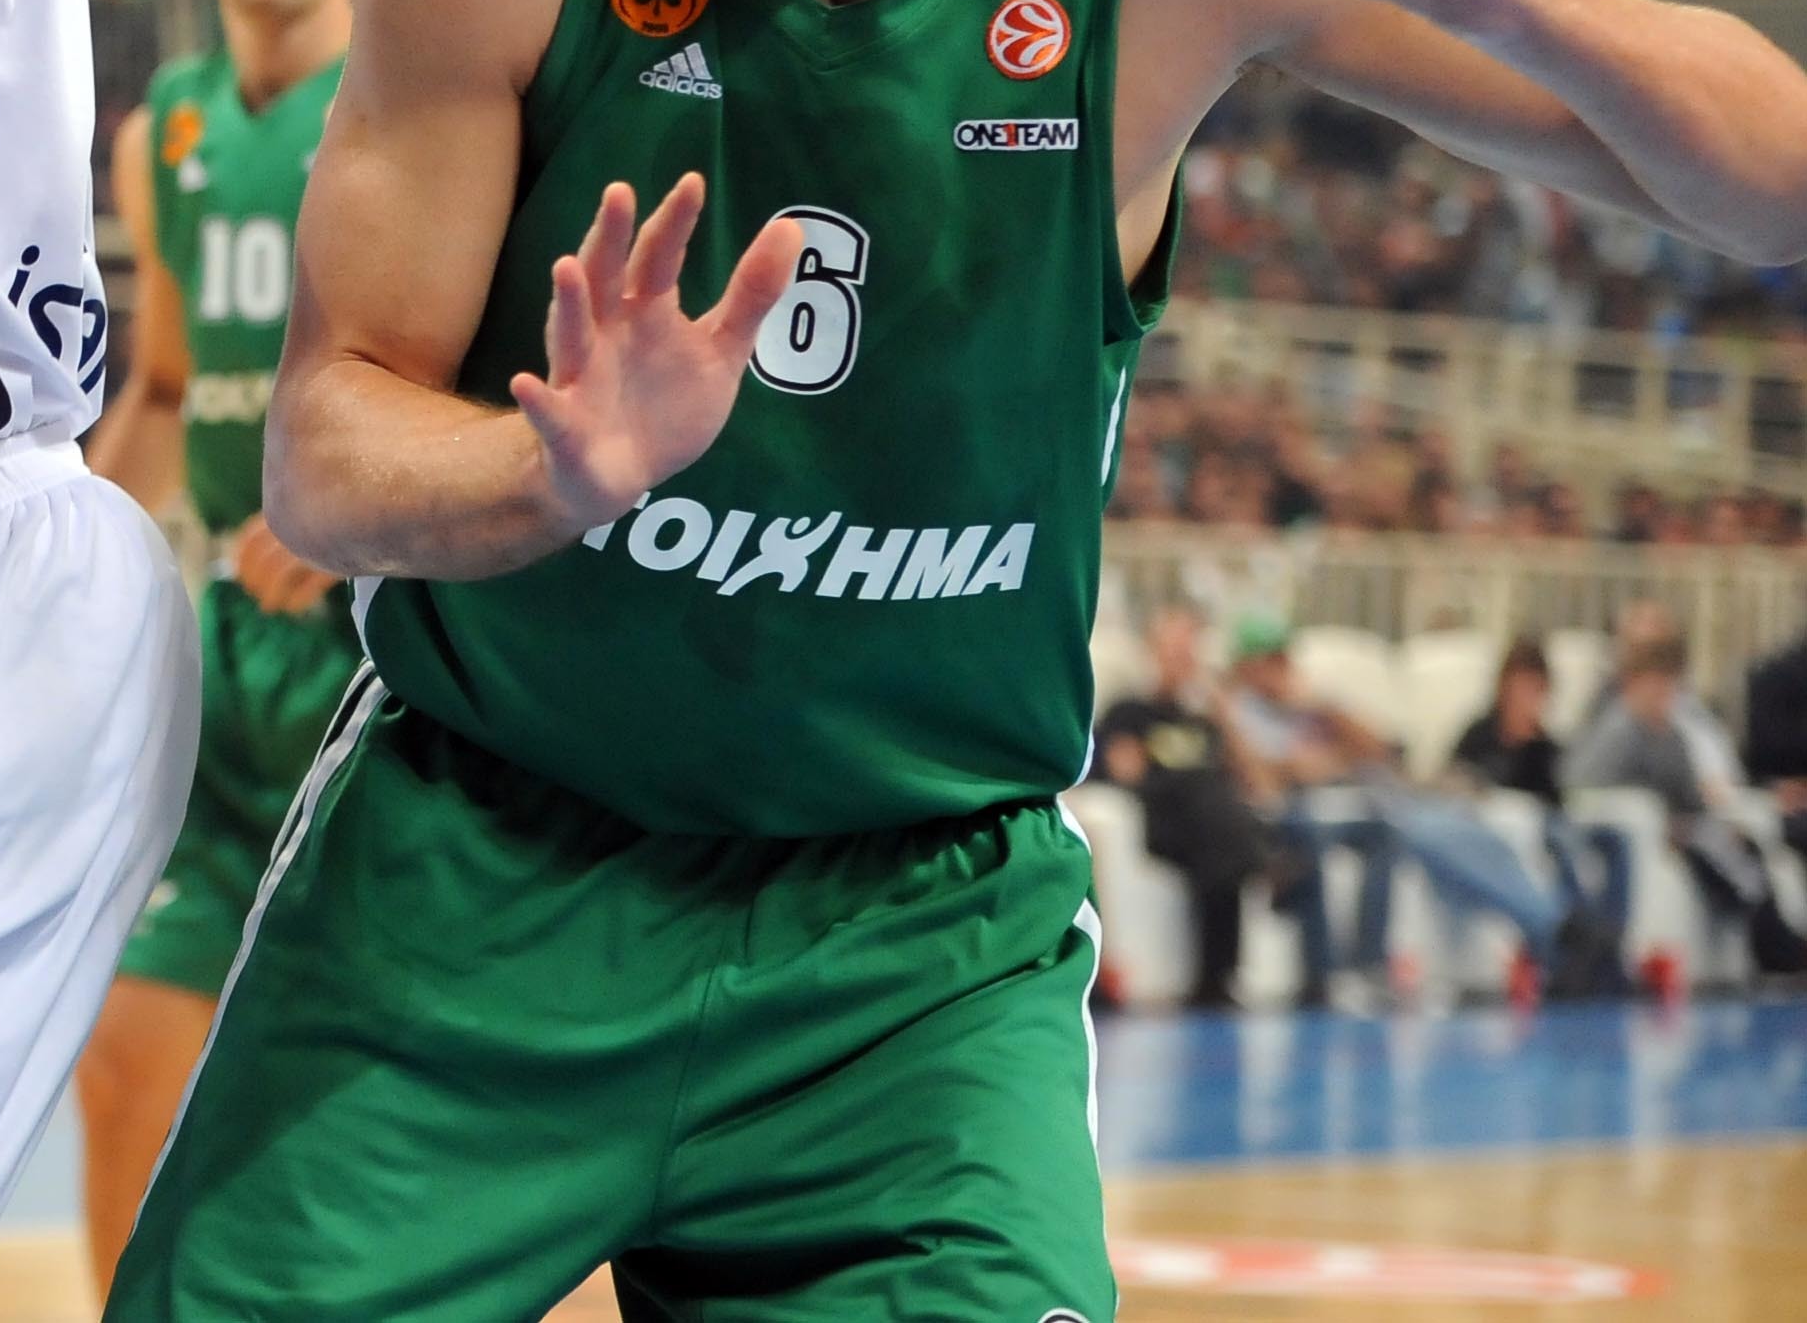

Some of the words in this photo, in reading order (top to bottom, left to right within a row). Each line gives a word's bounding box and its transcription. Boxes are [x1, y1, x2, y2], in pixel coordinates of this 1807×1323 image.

[639, 70, 723, 99] adidas
[199, 216, 290, 322] 10
[749, 205, 870, 396] 6
